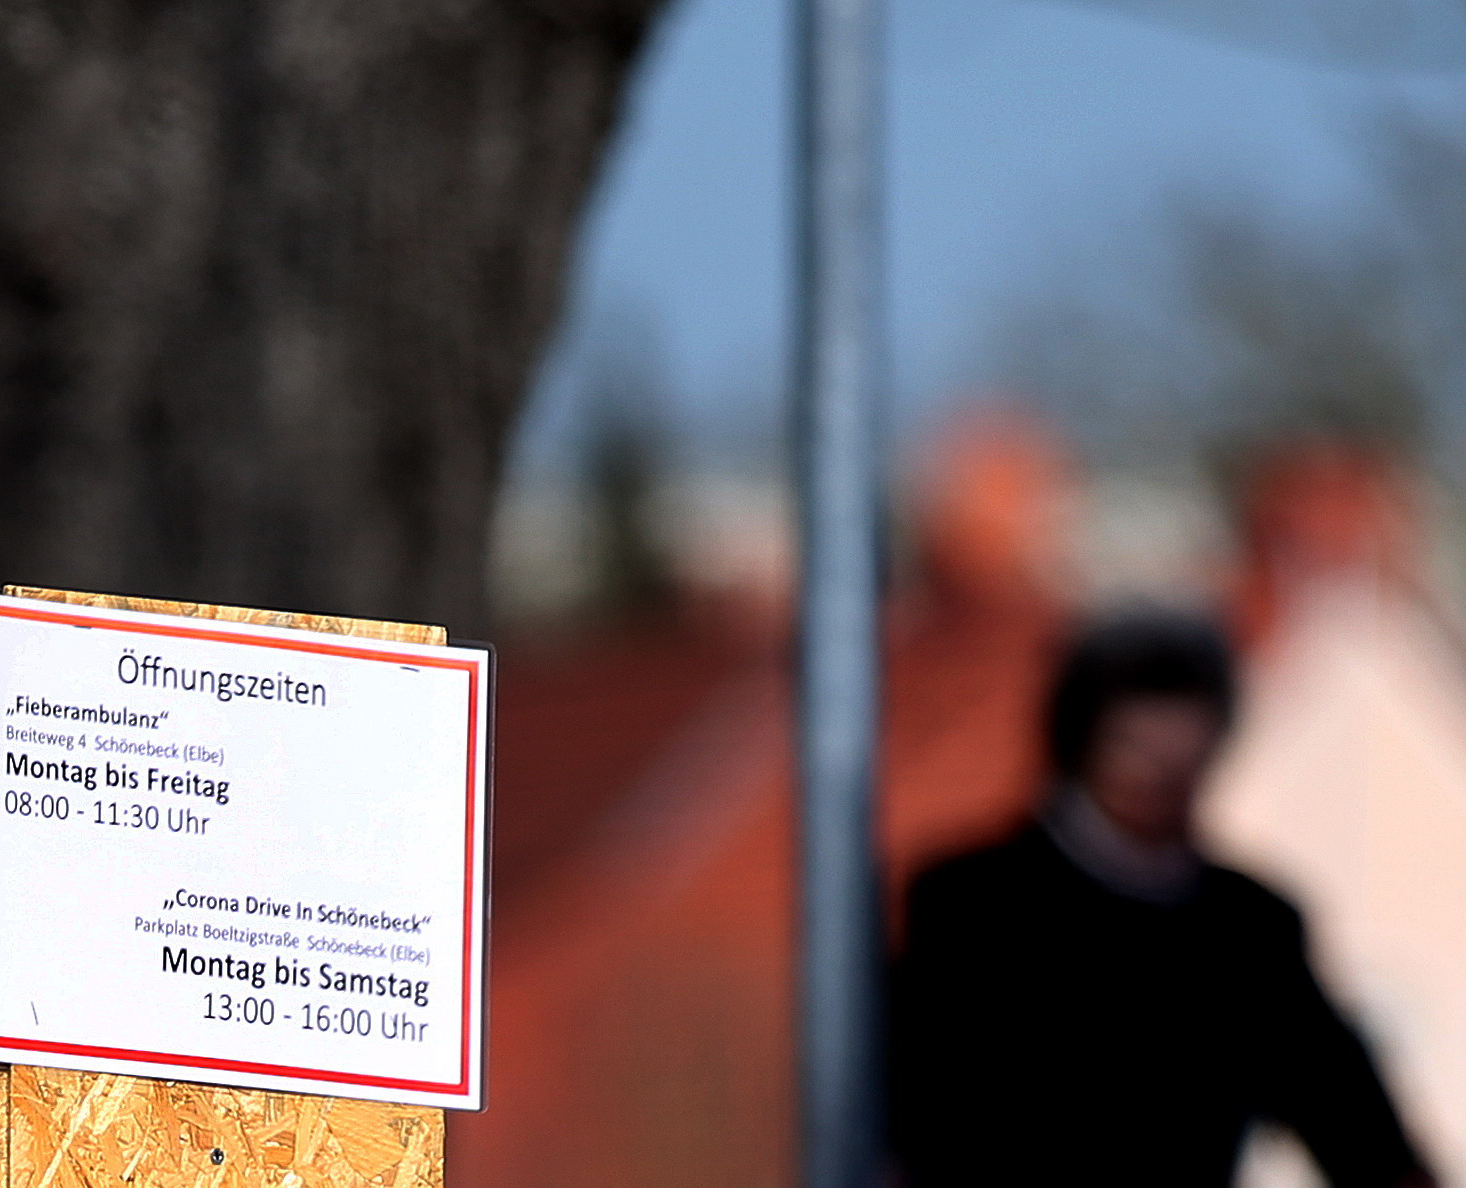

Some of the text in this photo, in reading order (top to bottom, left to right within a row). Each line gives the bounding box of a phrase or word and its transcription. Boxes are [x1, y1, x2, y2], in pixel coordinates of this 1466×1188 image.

[117, 647, 327, 707] Öffnungszeiten
[5, 694, 170, 730] „Fieberambulanz“
[6, 724, 225, 767] Breiteweg 4 Schönebeck (Elbe)
[5, 751, 231, 806] Montag bis Freitag
[4, 789, 70, 821] 08:00
[93, 800, 160, 831] 11:30
[167, 807, 211, 836] Uhr
[134, 916, 199, 938] Parkplatz
[203, 923, 300, 949] Boeltzigstraße
[162, 887, 432, 934] „Corona Drive In Schönebeck“
[162, 945, 430, 1008] Montag bis Samstag
[203, 992, 275, 1026] 13:00
[301, 1003, 372, 1037] 16:00
[381, 1012, 429, 1042] Uhr
